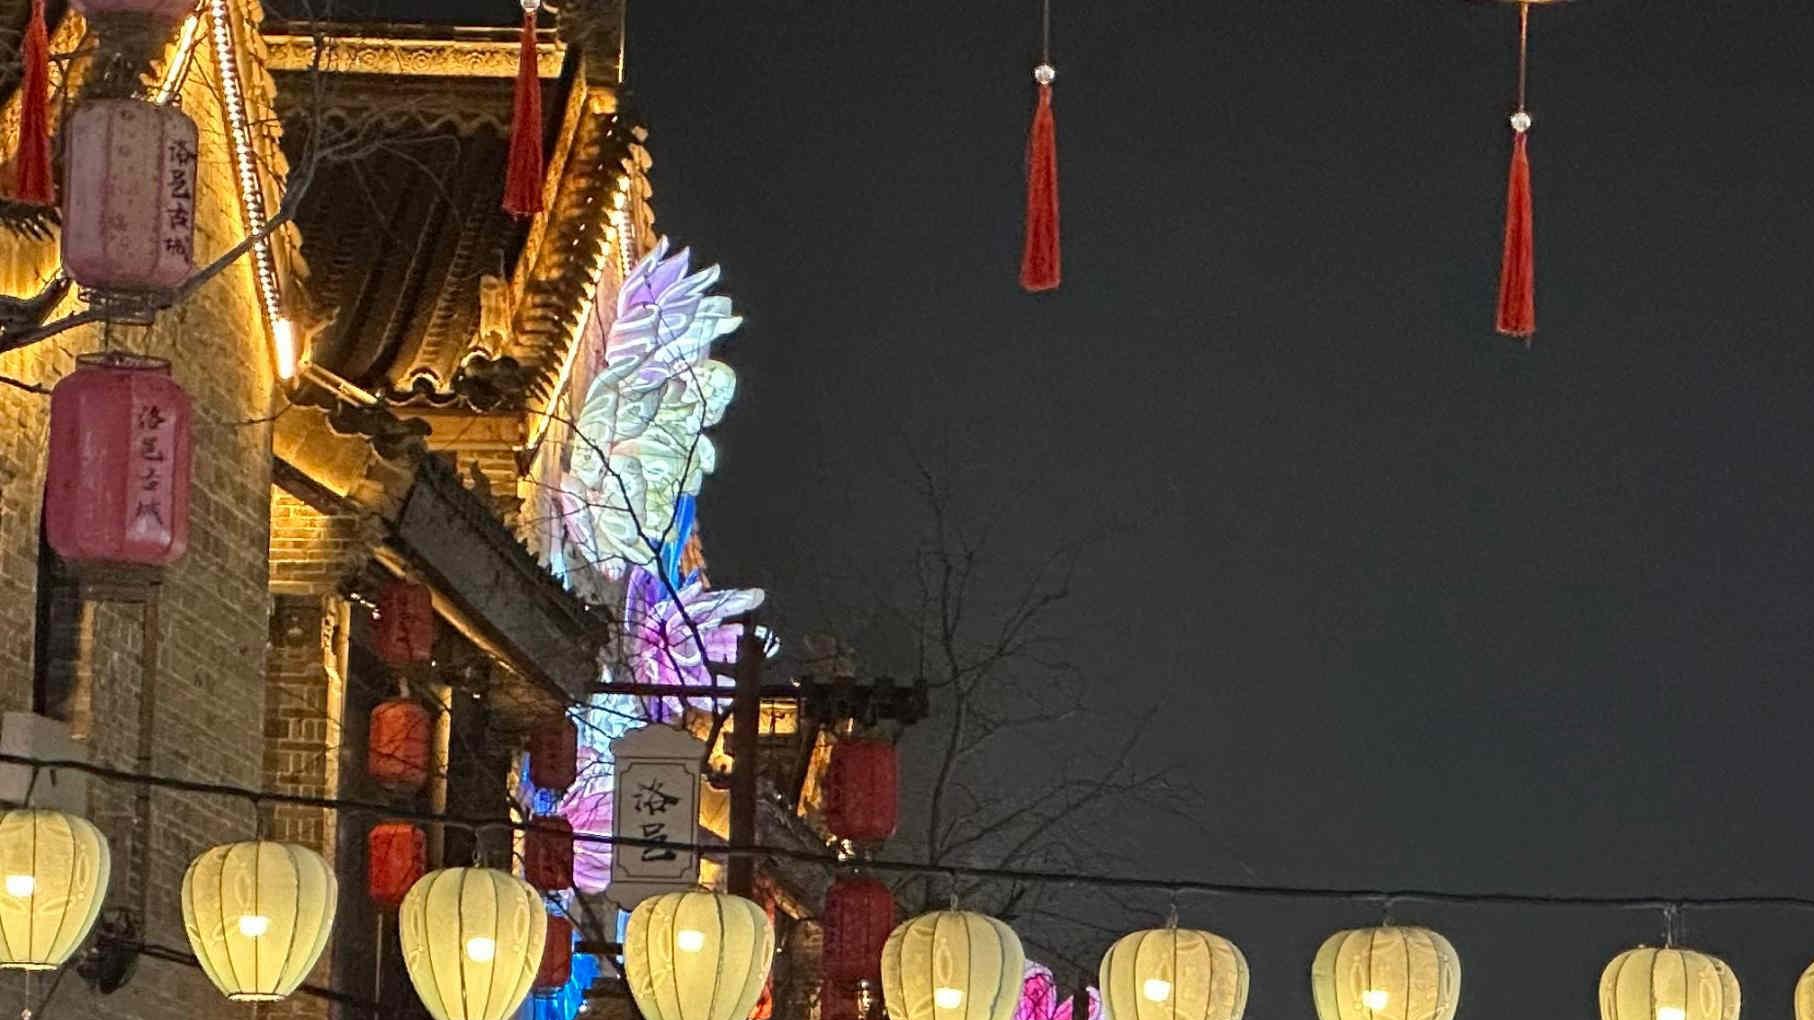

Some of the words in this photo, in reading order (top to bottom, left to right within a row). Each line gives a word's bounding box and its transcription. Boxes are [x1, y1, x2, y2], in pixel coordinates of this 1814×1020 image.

[166, 140, 197, 264] 洛邑古城
[136, 405, 166, 525] 洛邑古城
[633, 776, 680, 861] 洛邑
